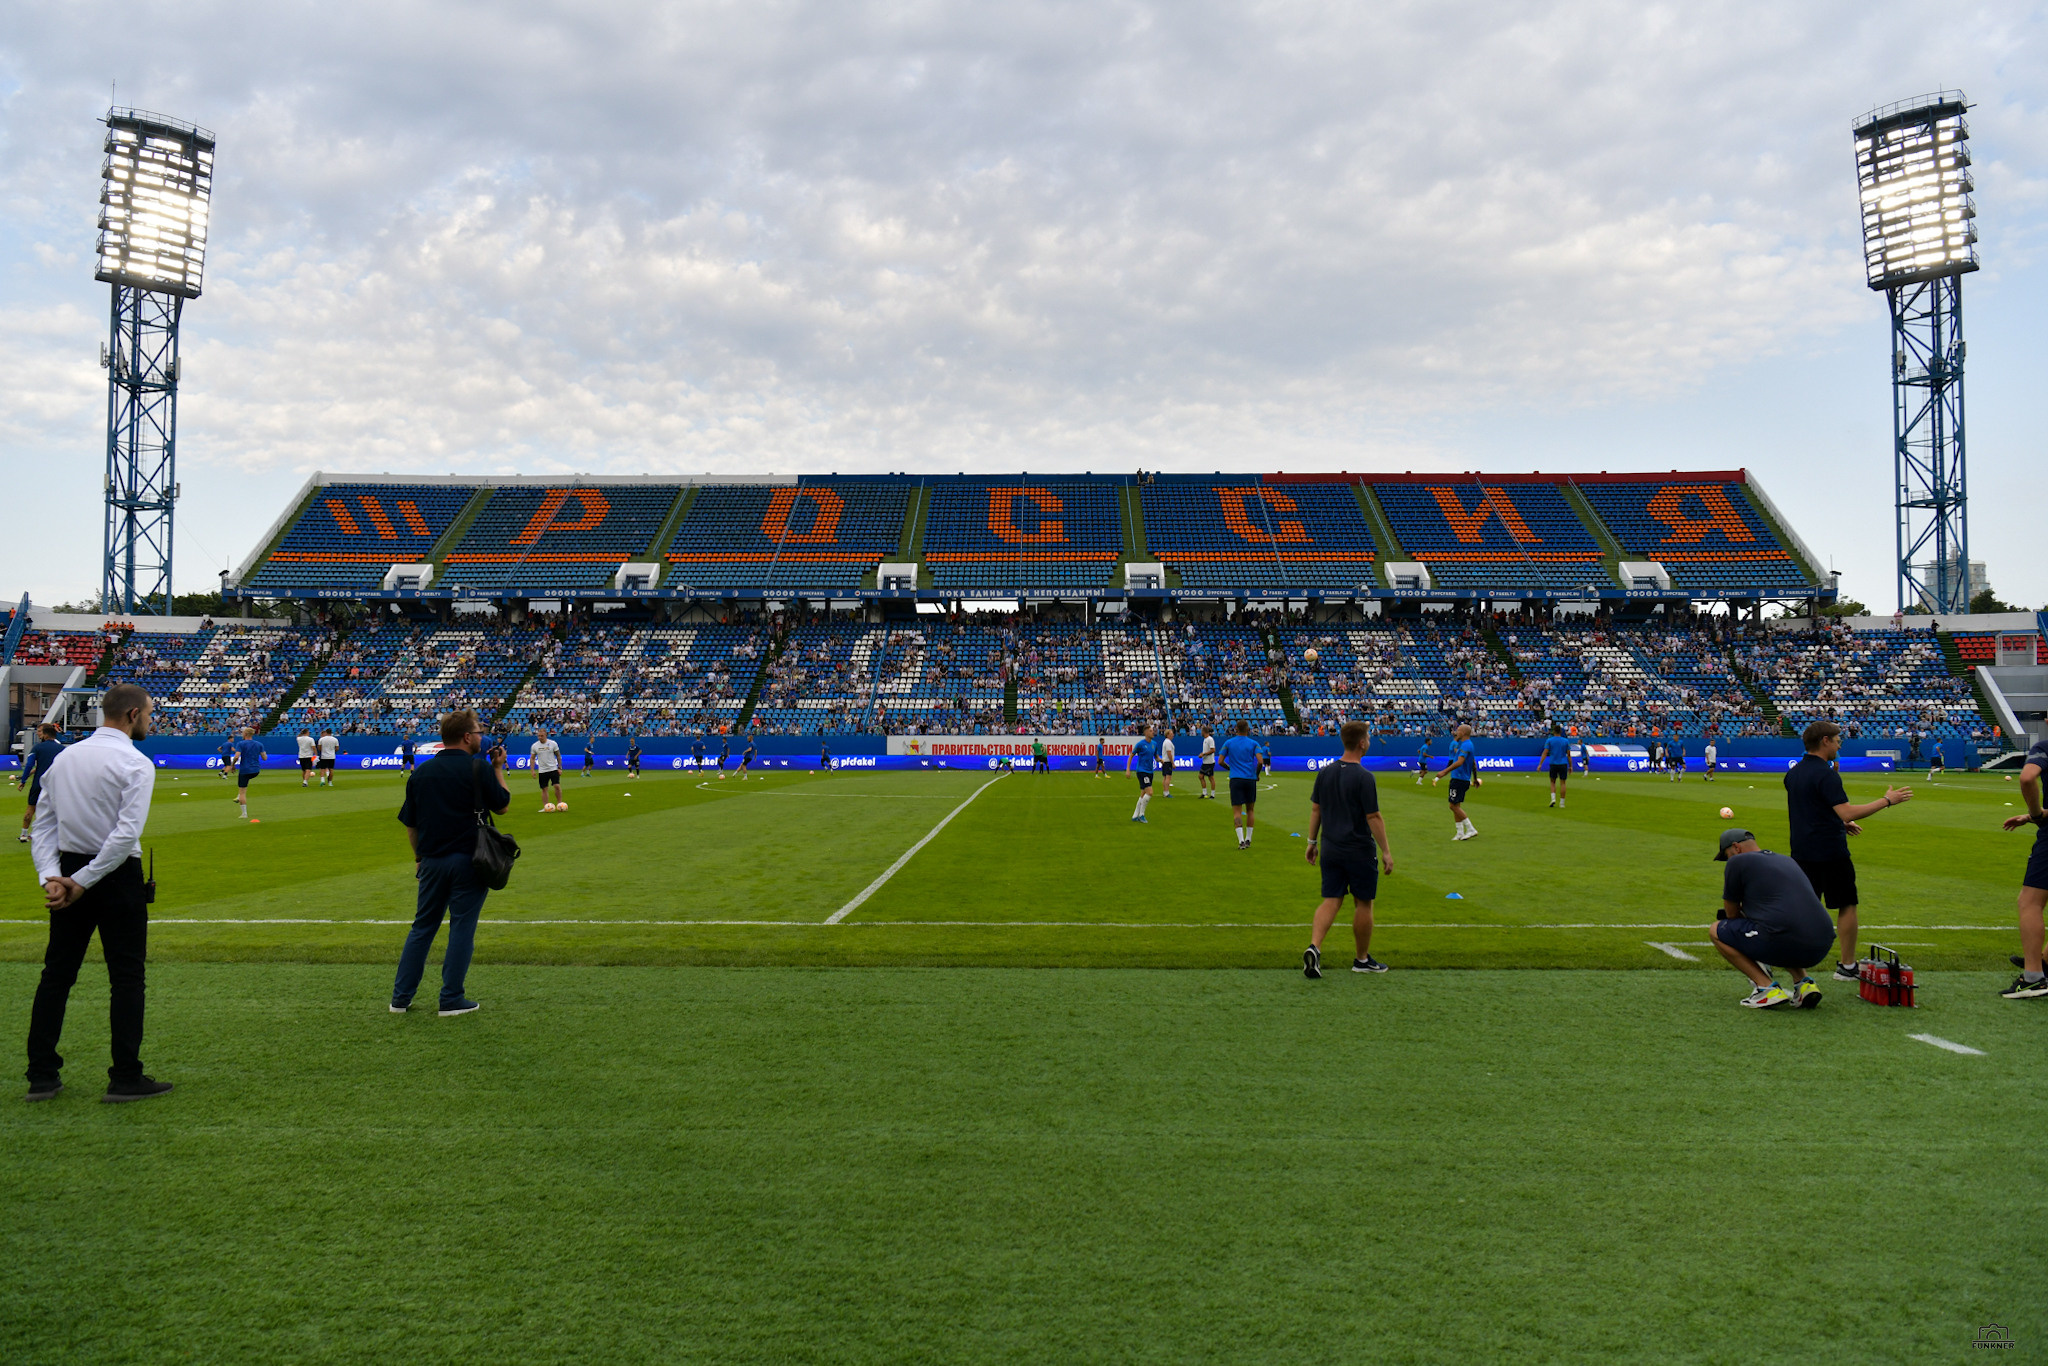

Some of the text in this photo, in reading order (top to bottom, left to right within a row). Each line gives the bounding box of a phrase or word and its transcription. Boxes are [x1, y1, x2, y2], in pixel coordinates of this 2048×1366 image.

[1034, 588, 1105, 597] НЕПОБЕДИМЫ!
[932, 743, 1012, 756] ПРАВИТЕЛЬСТВО
[1088, 744, 1133, 756] ОЛАСТИ
[361, 757, 403, 768] @pfcfake
